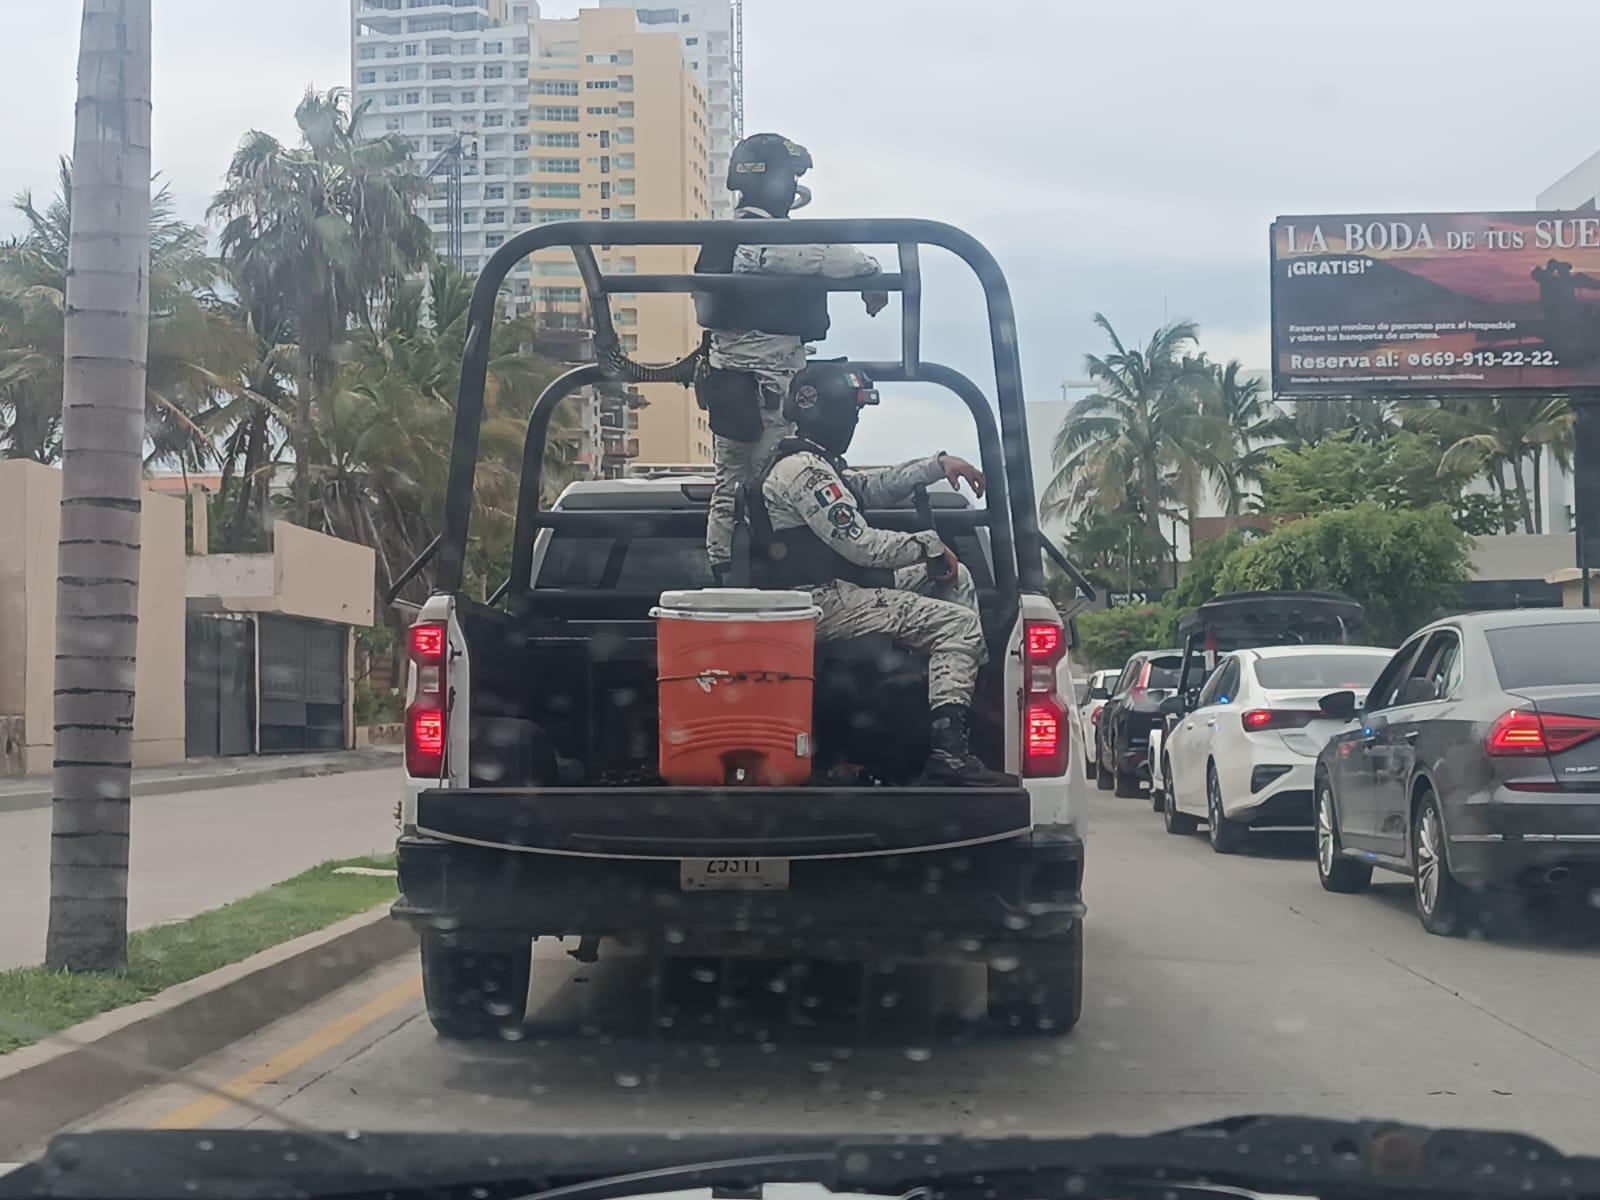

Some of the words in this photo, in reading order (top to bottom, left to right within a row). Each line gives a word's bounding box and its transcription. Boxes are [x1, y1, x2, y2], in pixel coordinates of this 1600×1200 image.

[1285, 224, 1328, 253] LA
[1344, 221, 1435, 252] BODA
[1447, 231, 1475, 249] DE
[1484, 230, 1524, 249] TUS
[1377, 321, 1389, 330] de
[1391, 323, 1434, 332] personas
[1435, 322, 1456, 331] para
[1468, 320, 1517, 331] hospedaje
[1289, 335, 1296, 343] y
[1327, 333, 1337, 341] tu
[1339, 332, 1384, 342] banquete
[1385, 332, 1398, 340] de
[1291, 354, 1371, 369] Reserva
[1375, 352, 1399, 367] al:
